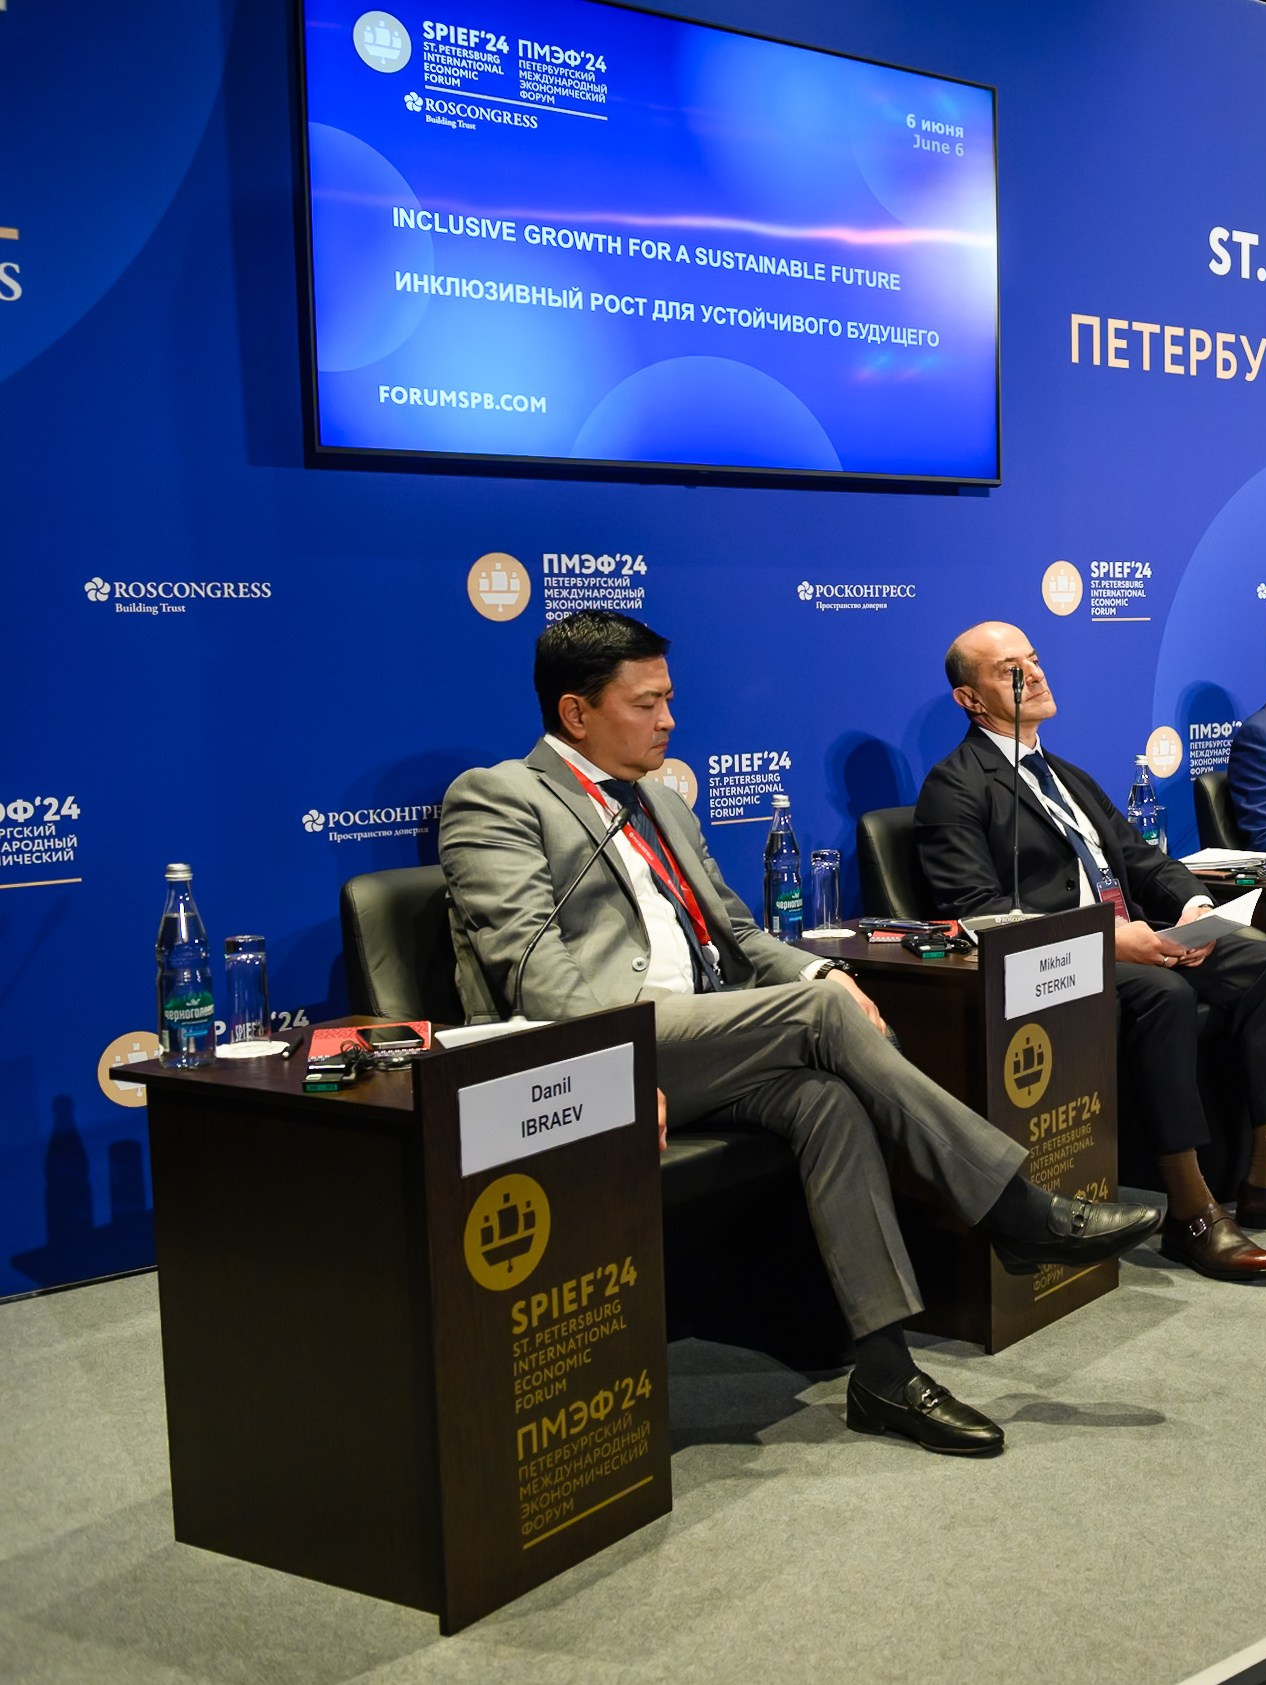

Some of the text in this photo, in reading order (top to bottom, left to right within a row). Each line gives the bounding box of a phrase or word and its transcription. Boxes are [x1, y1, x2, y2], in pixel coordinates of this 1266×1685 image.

[423, 41, 501, 64] ST. PETERSBURG
[423, 52, 504, 75] INTERNATIONAL
[423, 63, 479, 81] ECONOMIC
[424, 73, 461, 87] FORUM
[518, 59, 596, 82] ПЕТЕРБУРГСКИЙ
[518, 69, 608, 94] МЕЖДУНАРОДНЫЙ
[519, 80, 606, 104] ЭКОНОМИЧЕСКИЙ
[519, 90, 555, 105] ФОРУМ
[425, 98, 538, 129] ROSCONGRESS
[425, 114, 476, 130] Building Trust
[906, 114, 965, 139] 6 июня
[912, 135, 965, 158] June 6
[392, 206, 901, 291] INCLUSIVE GROWTH FOR A SUSTAINABLE FUTURE
[394, 270, 940, 348] ИНКЛЮЗИВНЫЙ РОСТ ДЛЯ УСТОЙЧИВОГО БУДУЩЕГО
[379, 385, 548, 414] FORUMSPB.COM
[113, 582, 272, 598] ROSCONGRESS
[544, 576, 630, 587] ПЕТЕРБУРГСКИЙ
[544, 587, 645, 599] МЕЖДУНАРОДНЫЙ
[815, 584, 916, 598] РОСКОНГРЕСС
[1090, 580, 1144, 588] ST. PETERSBURG
[545, 599, 642, 609] ЭКОНОМИЧЕСКИЙ
[1090, 589, 1146, 598] INTERNATIONAL
[1091, 598, 1128, 607] ECONOMIC
[115, 602, 186, 615] Building Trust
[1091, 607, 1116, 616] FORUM
[709, 773, 781, 787] ST. PETERSBURG
[1190, 766, 1214, 775] ФОРУМ
[709, 783, 784, 797] INTERNATIONAL
[709, 795, 760, 808] ECONOMIC
[710, 807, 744, 818] FORUM
[329, 830, 393, 843] Пространство
[0, 848, 74, 867] ИЧЕСКИЙ
[1040, 952, 1071, 973] Mikhail
[1035, 974, 1076, 998] STERKIN
[531, 1076, 571, 1102] Danil
[521, 1104, 583, 1138] IBRAEV
[1030, 1123, 1092, 1159] ST. PETERSBURG
[1030, 1136, 1094, 1173] INTERNATIONAL
[1030, 1158, 1075, 1185] ECONOMIC
[513, 1300, 622, 1358] ST. PETERSBURG
[513, 1316, 628, 1377] INTERNATIONAL
[514, 1349, 592, 1396] ECONOMIC
[515, 1378, 568, 1414] FORUM
[518, 1411, 633, 1481] ПЕТЕРБУРГСКИЙ
[519, 1420, 651, 1501] МЕЖДУНАРОДНЫЙ
[520, 1440, 649, 1519] ЭКОНОМИЧЕСКИЙ
[521, 1498, 575, 1535] ФОРУМ
